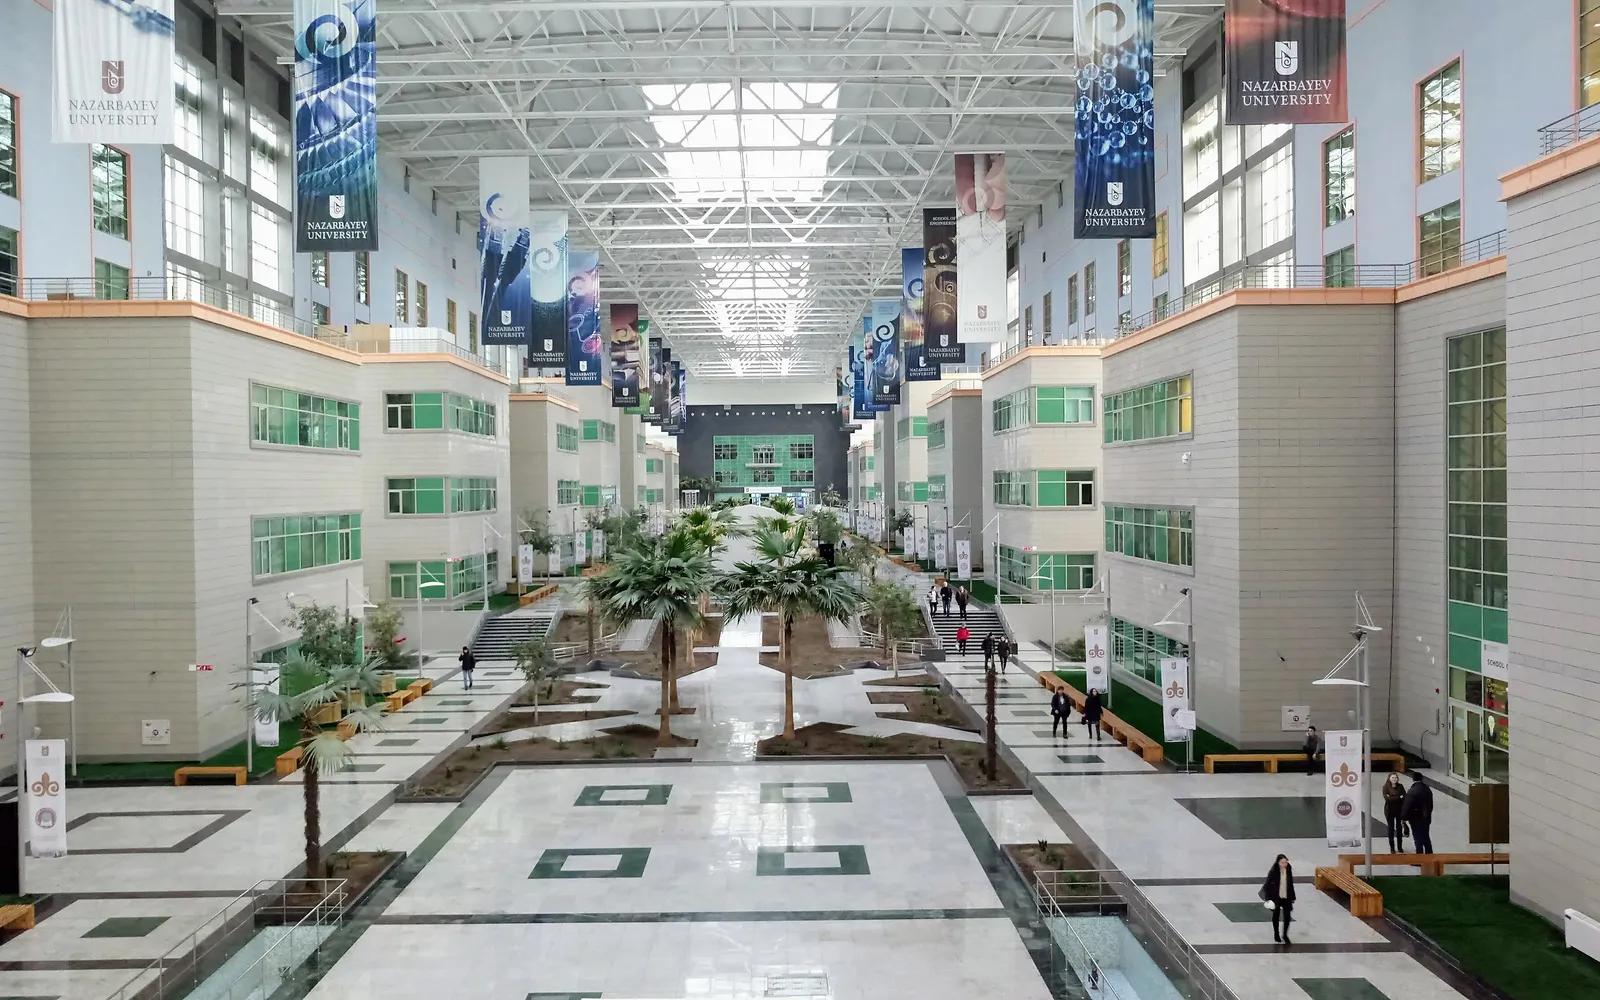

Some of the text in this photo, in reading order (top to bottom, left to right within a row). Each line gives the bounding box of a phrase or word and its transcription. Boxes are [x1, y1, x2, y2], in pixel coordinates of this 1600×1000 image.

[1242, 79, 1332, 91] NAZARBAYEV
[68, 99, 159, 111] NAZARBAYEV
[1243, 93, 1332, 106] UNIVERSITY
[68, 114, 159, 126] UNIVERSITY
[1085, 208, 1146, 217] NAZARBAYEV
[307, 221, 368, 230] NAZARBAYEV
[1085, 218, 1146, 227] UNIVERSITY
[307, 231, 368, 240] UNIVERSITY
[1486, 658, 1505, 669] SCHOOL
